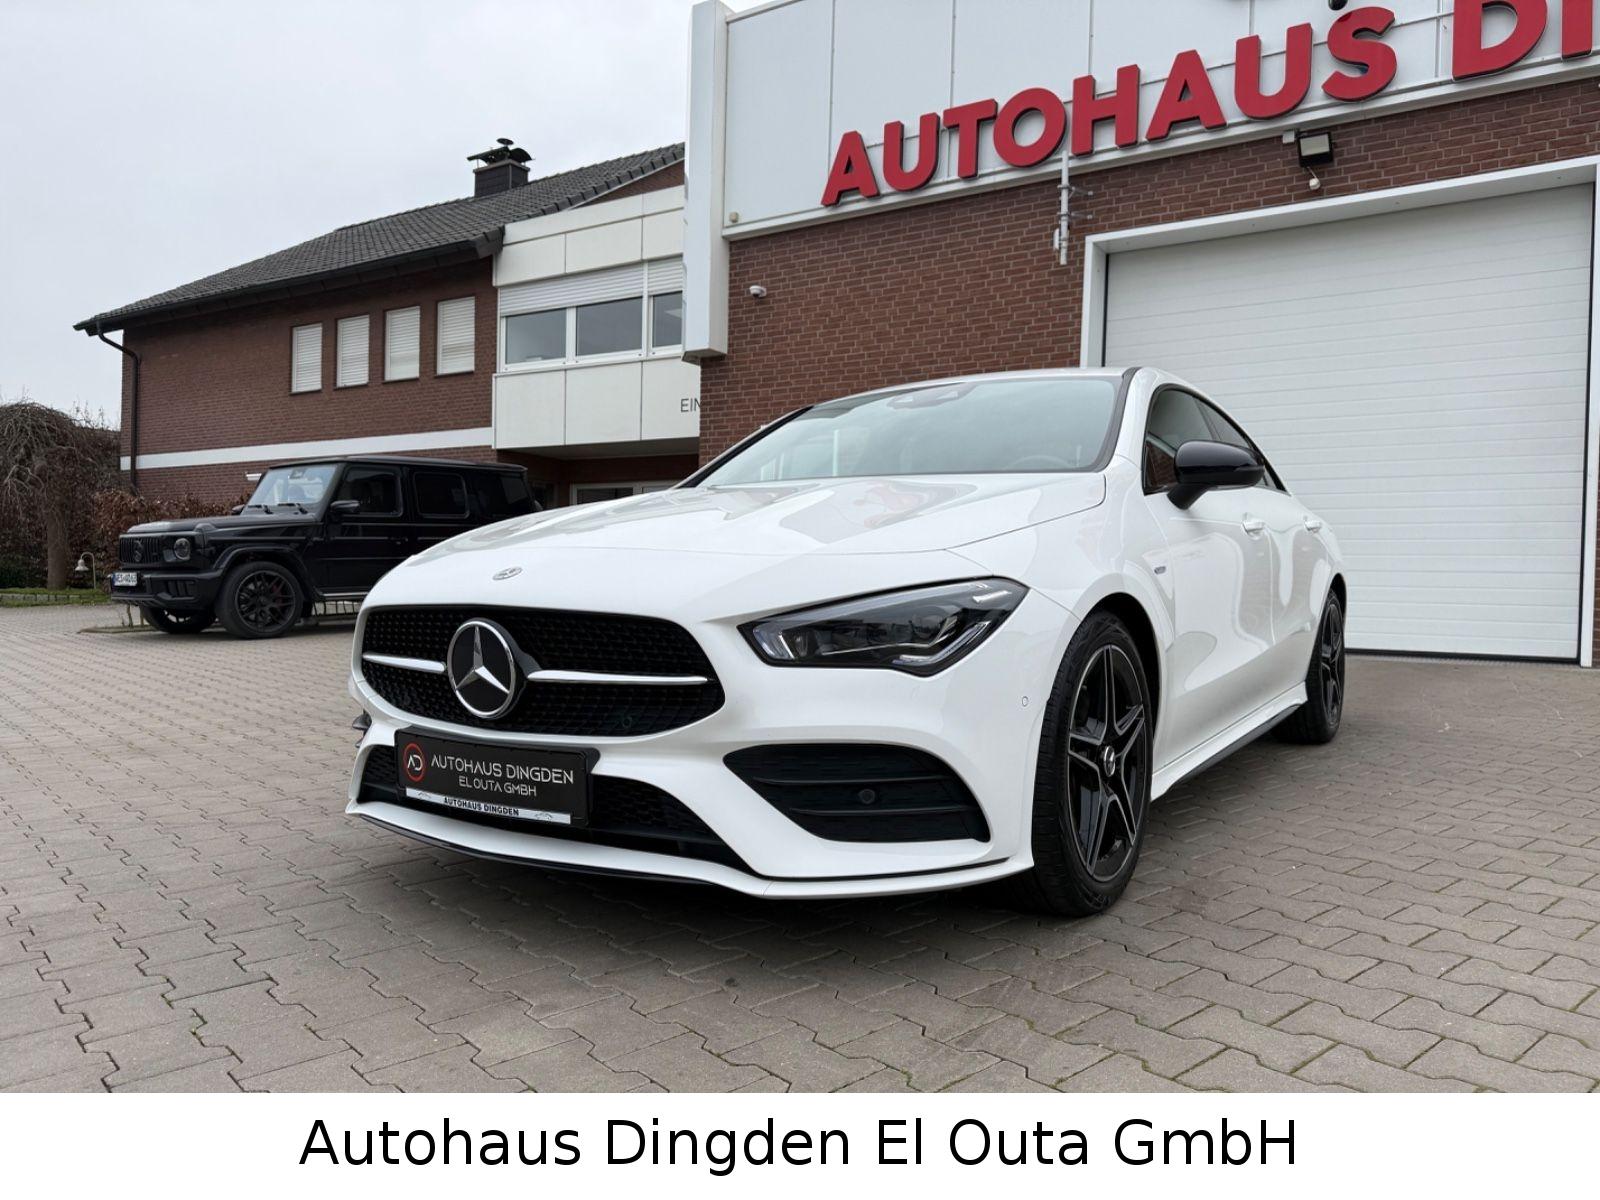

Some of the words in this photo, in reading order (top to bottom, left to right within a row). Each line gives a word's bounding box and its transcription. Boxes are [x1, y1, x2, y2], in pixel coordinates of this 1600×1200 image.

[821, 6, 1398, 206] AUTOHAUS
[431, 754, 502, 777] AUTOHAUS
[505, 764, 574, 784] DINGDEN
[458, 775, 472, 788] EL
[473, 778, 502, 793] OUTA
[504, 782, 537, 796] GMBH
[444, 796, 482, 811] AUTOHAUS
[484, 803, 520, 816] DINGDEN
